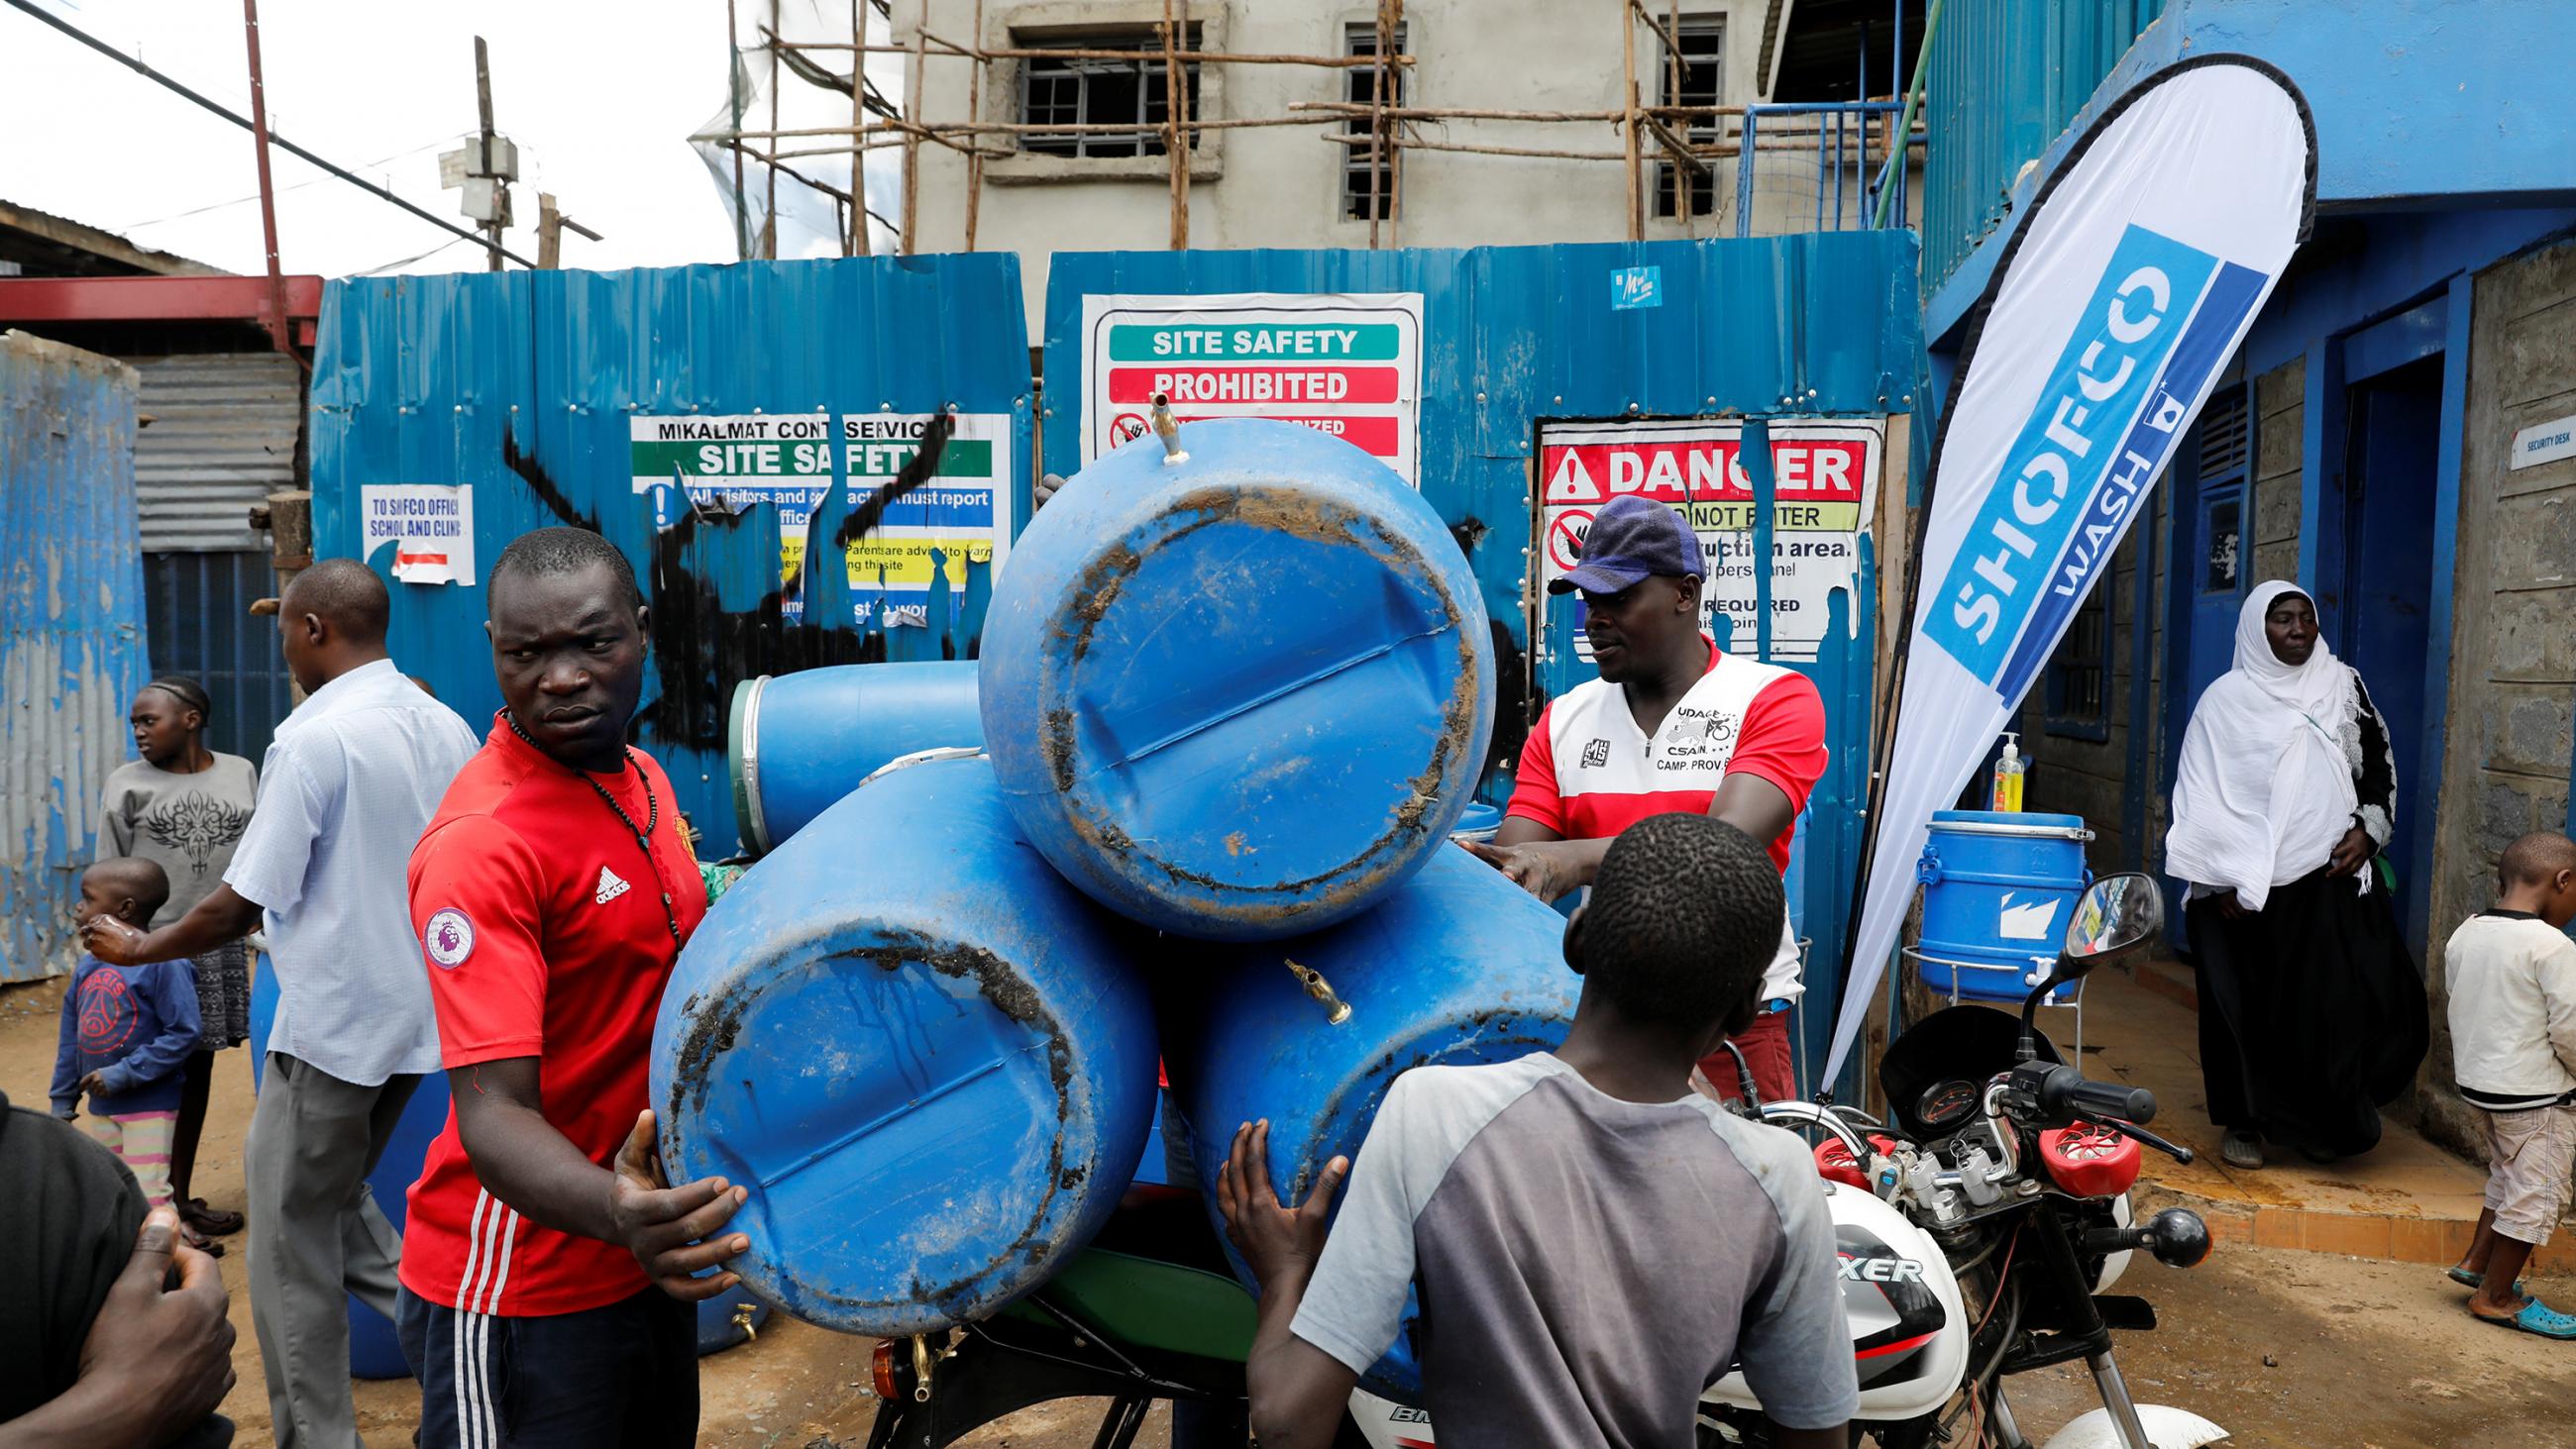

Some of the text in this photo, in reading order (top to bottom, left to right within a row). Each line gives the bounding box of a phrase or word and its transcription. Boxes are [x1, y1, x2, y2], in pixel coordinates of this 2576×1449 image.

[1152, 330, 1358, 355] SITE SAFETY
[1153, 371, 1348, 400] PROHIBITED
[659, 421, 769, 440] MIKALMAT
[845, 421, 925, 439] SERVIC
[2527, 432, 2571, 453] SECURITY DESK
[698, 444, 782, 474] SITE
[1953, 265, 2172, 646] SHOFCO
[373, 498, 387, 516] TO
[690, 488, 712, 504] All
[774, 488, 806, 504] and
[941, 491, 989, 509] report
[779, 508, 811, 525] ffice
[1695, 506, 1739, 527] NOT
[1746, 506, 1821, 527] ETER
[2054, 449, 2153, 597] WASH
[407, 519, 431, 537] AND
[949, 547, 961, 558] to
[1789, 542, 1852, 558] area.
[1704, 598, 1800, 615] REQURED
[1657, 759, 1689, 772] CAMP.
[1836, 1257, 1924, 1283] XER
